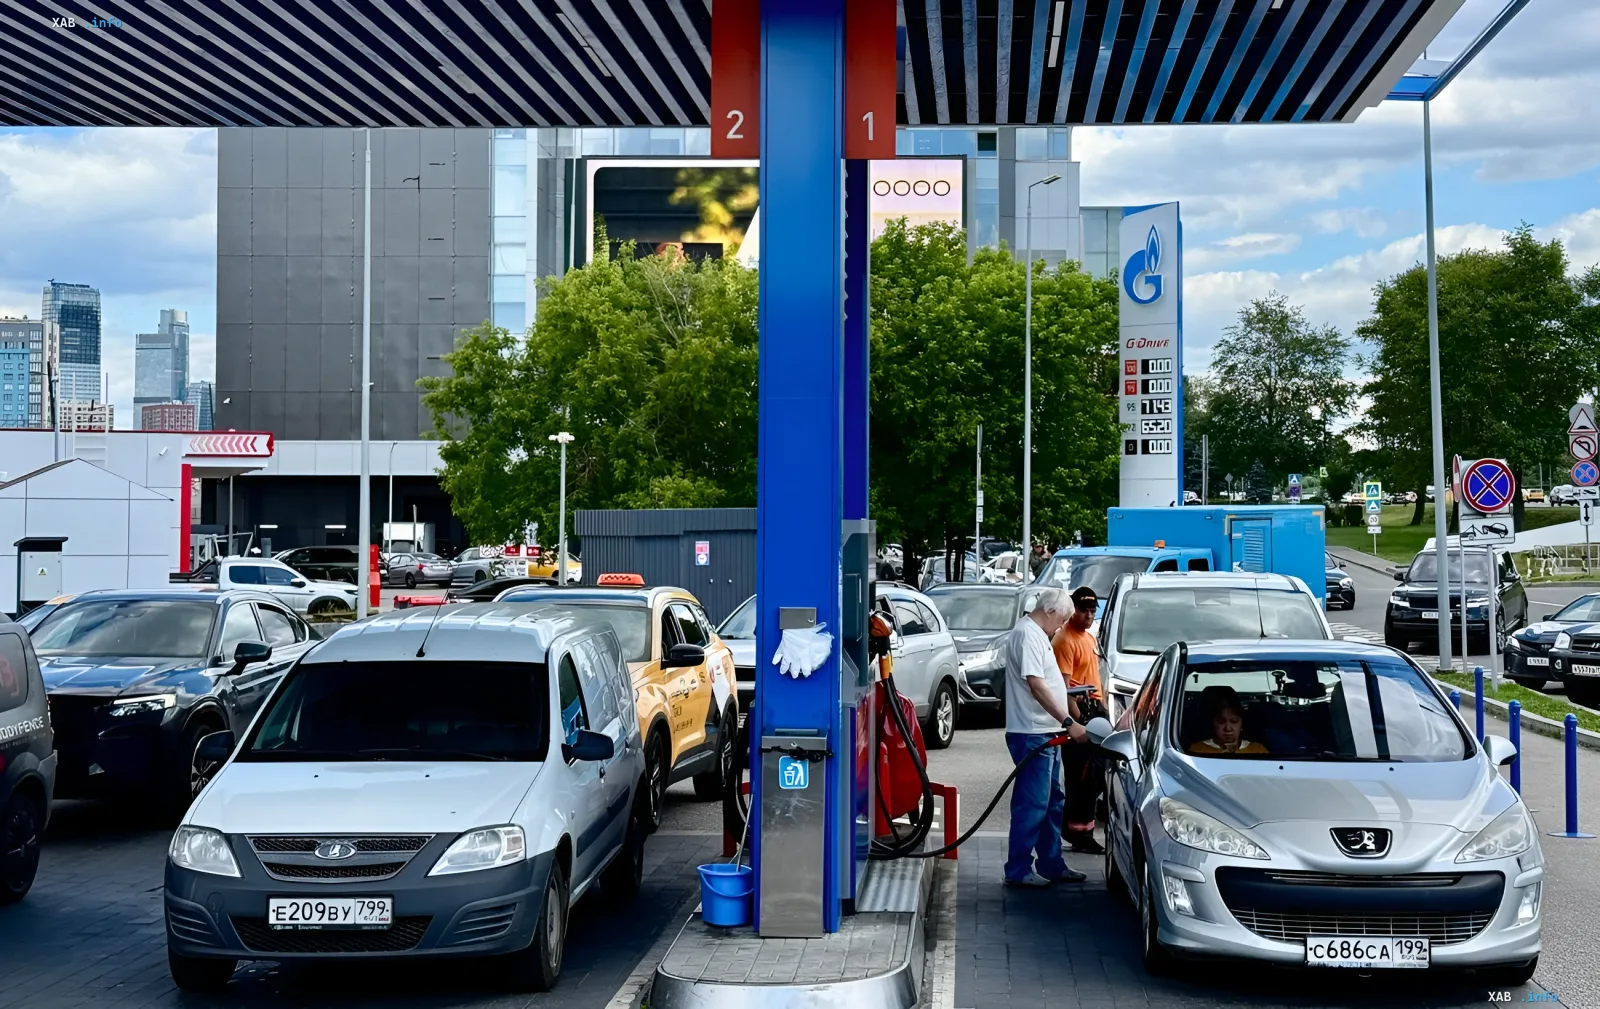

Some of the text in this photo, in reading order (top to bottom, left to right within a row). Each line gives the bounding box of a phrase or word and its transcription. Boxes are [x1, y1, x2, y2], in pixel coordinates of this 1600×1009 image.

[726, 109, 745, 139] 2
[862, 111, 874, 141] 1
[0, 716, 44, 740] DDYFENCE
[275, 902, 351, 921] Е209ВУ
[357, 901, 386, 916] 799
[1313, 940, 1424, 960] С686СА 199
